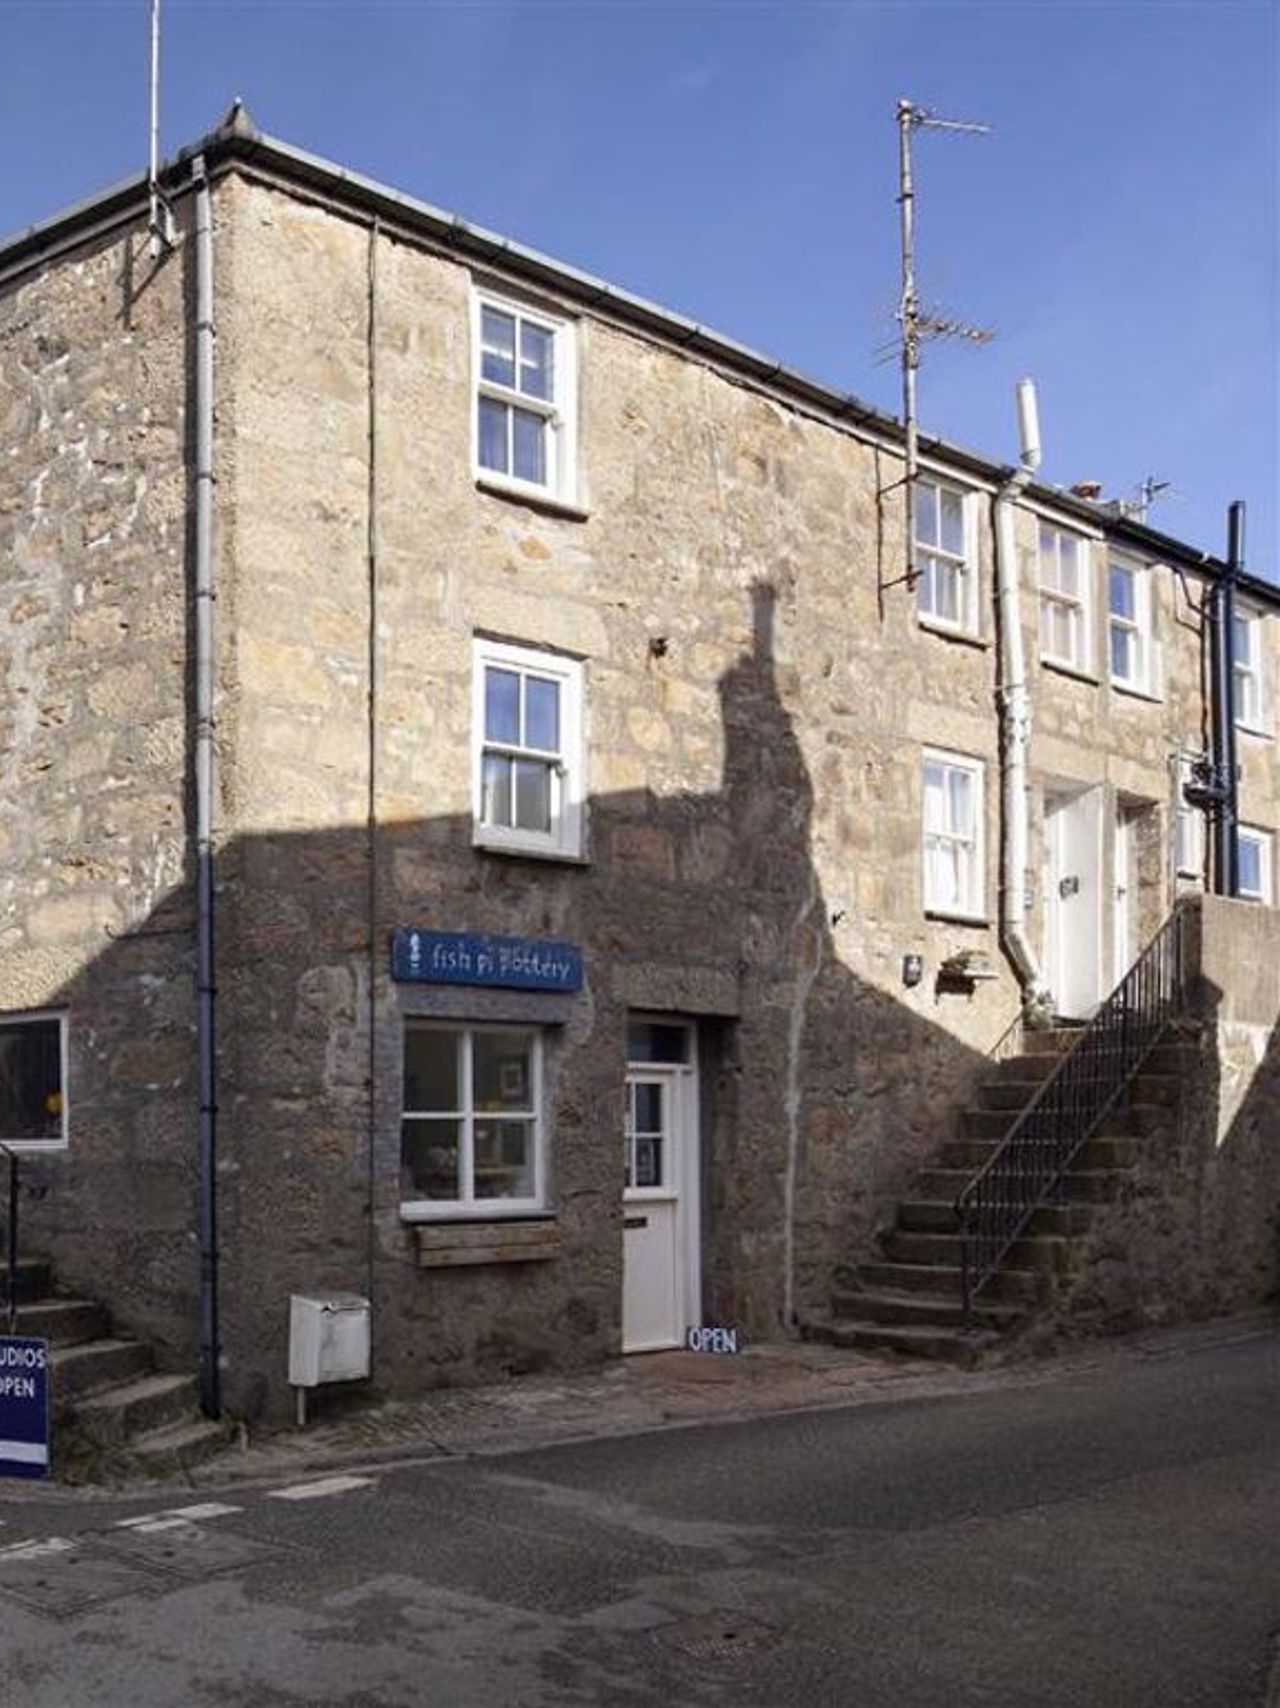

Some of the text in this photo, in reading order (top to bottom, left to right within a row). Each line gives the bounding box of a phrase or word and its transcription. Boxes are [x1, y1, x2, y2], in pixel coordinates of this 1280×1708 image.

[432, 942, 472, 970] fish
[499, 946, 571, 981] pottery
[689, 1327, 737, 1353] OPEN
